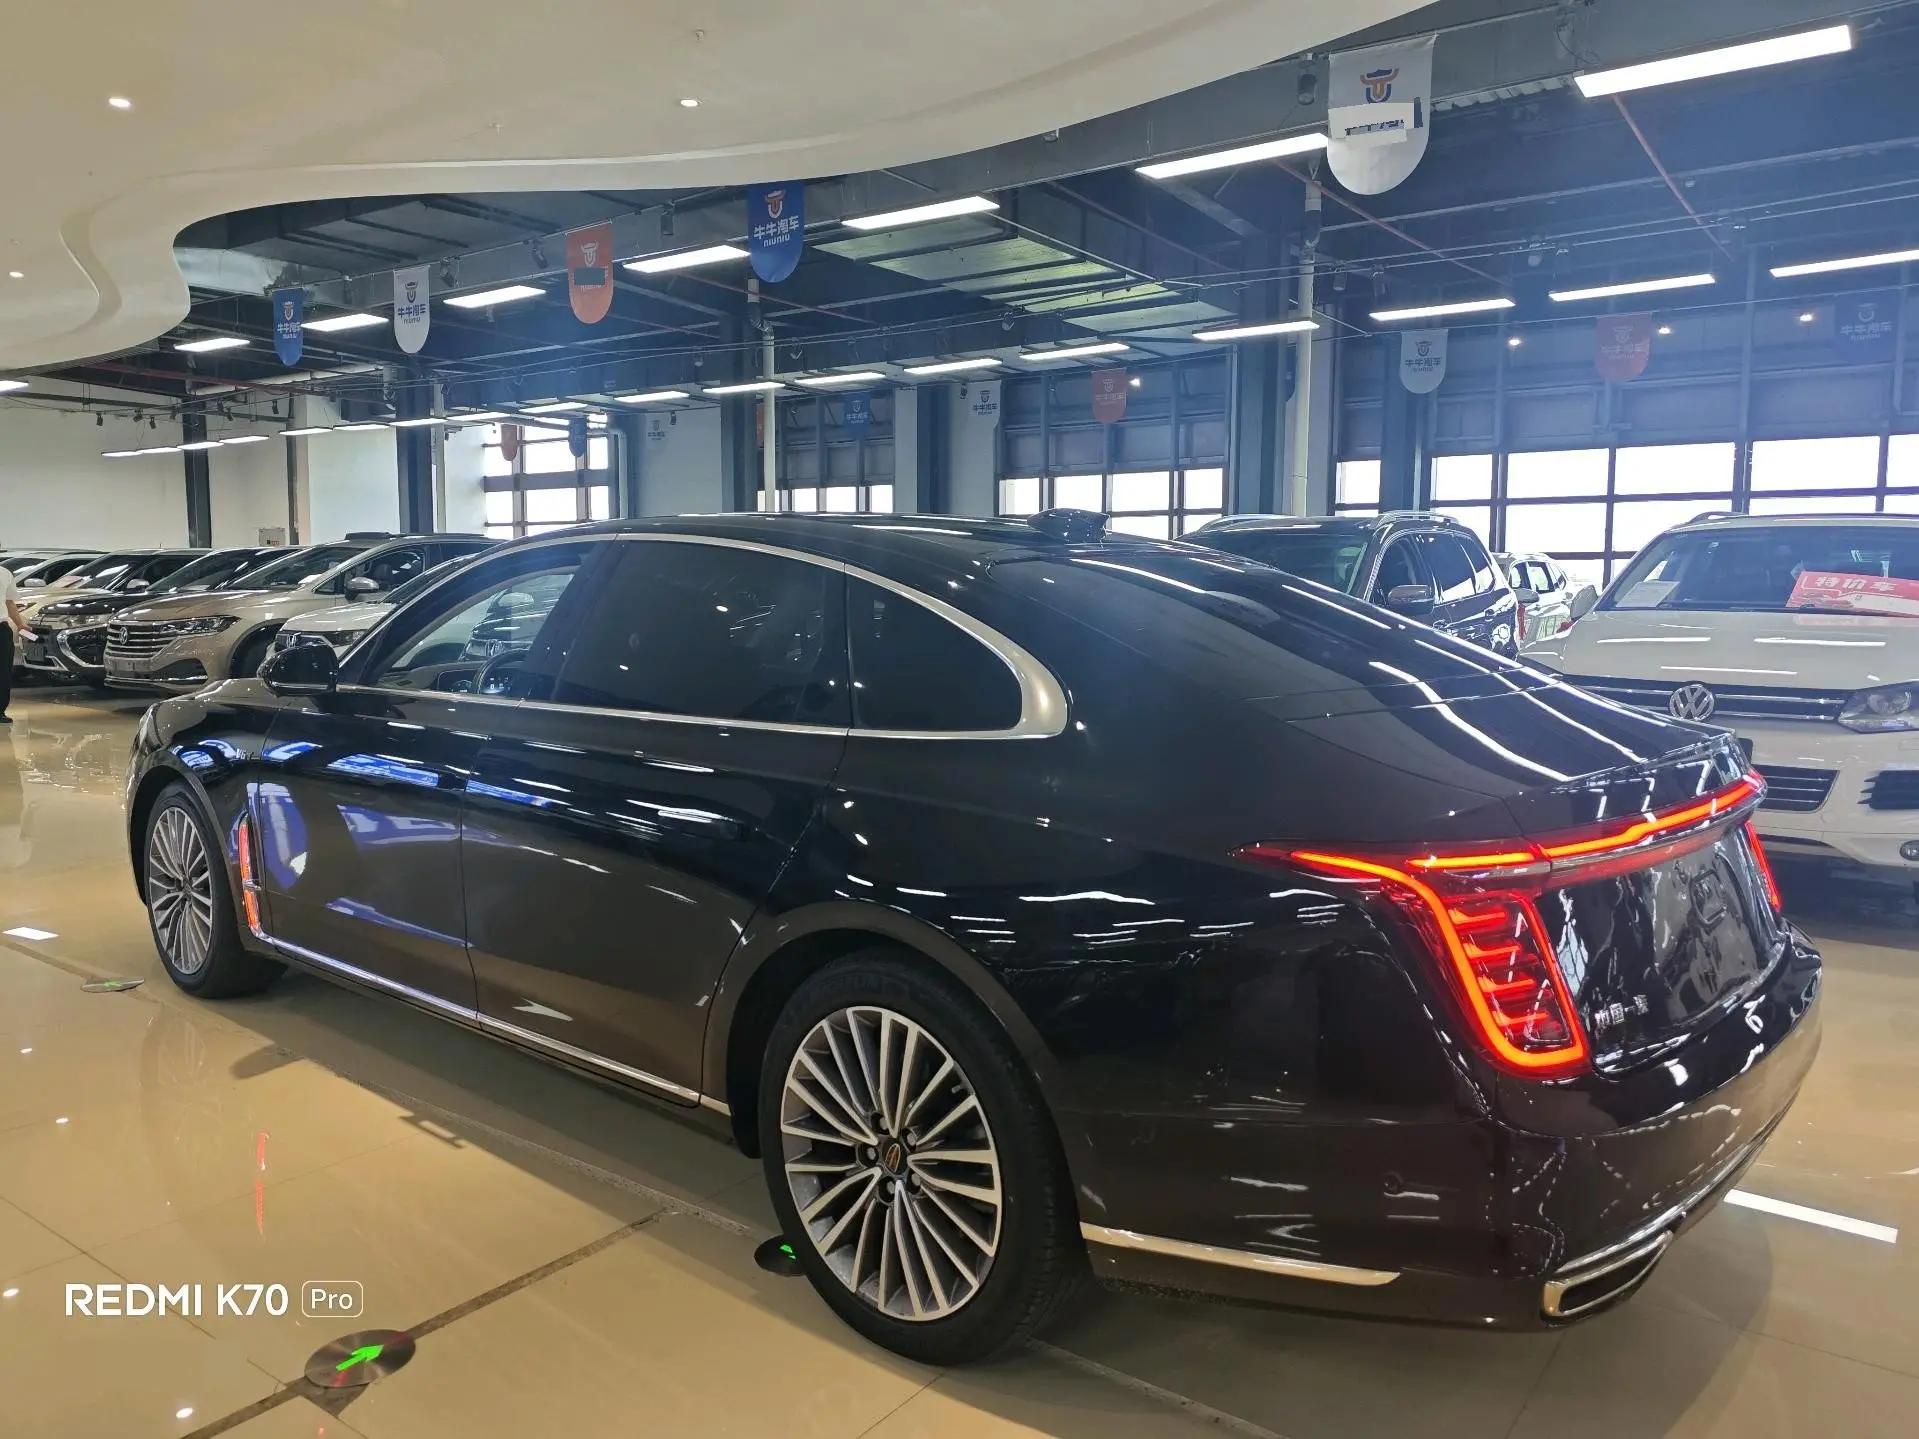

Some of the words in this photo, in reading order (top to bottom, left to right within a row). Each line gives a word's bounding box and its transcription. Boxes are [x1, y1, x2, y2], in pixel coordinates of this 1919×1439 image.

[754, 216, 800, 240] 牛牛淘车
[1815, 576, 1898, 592] 特价车
